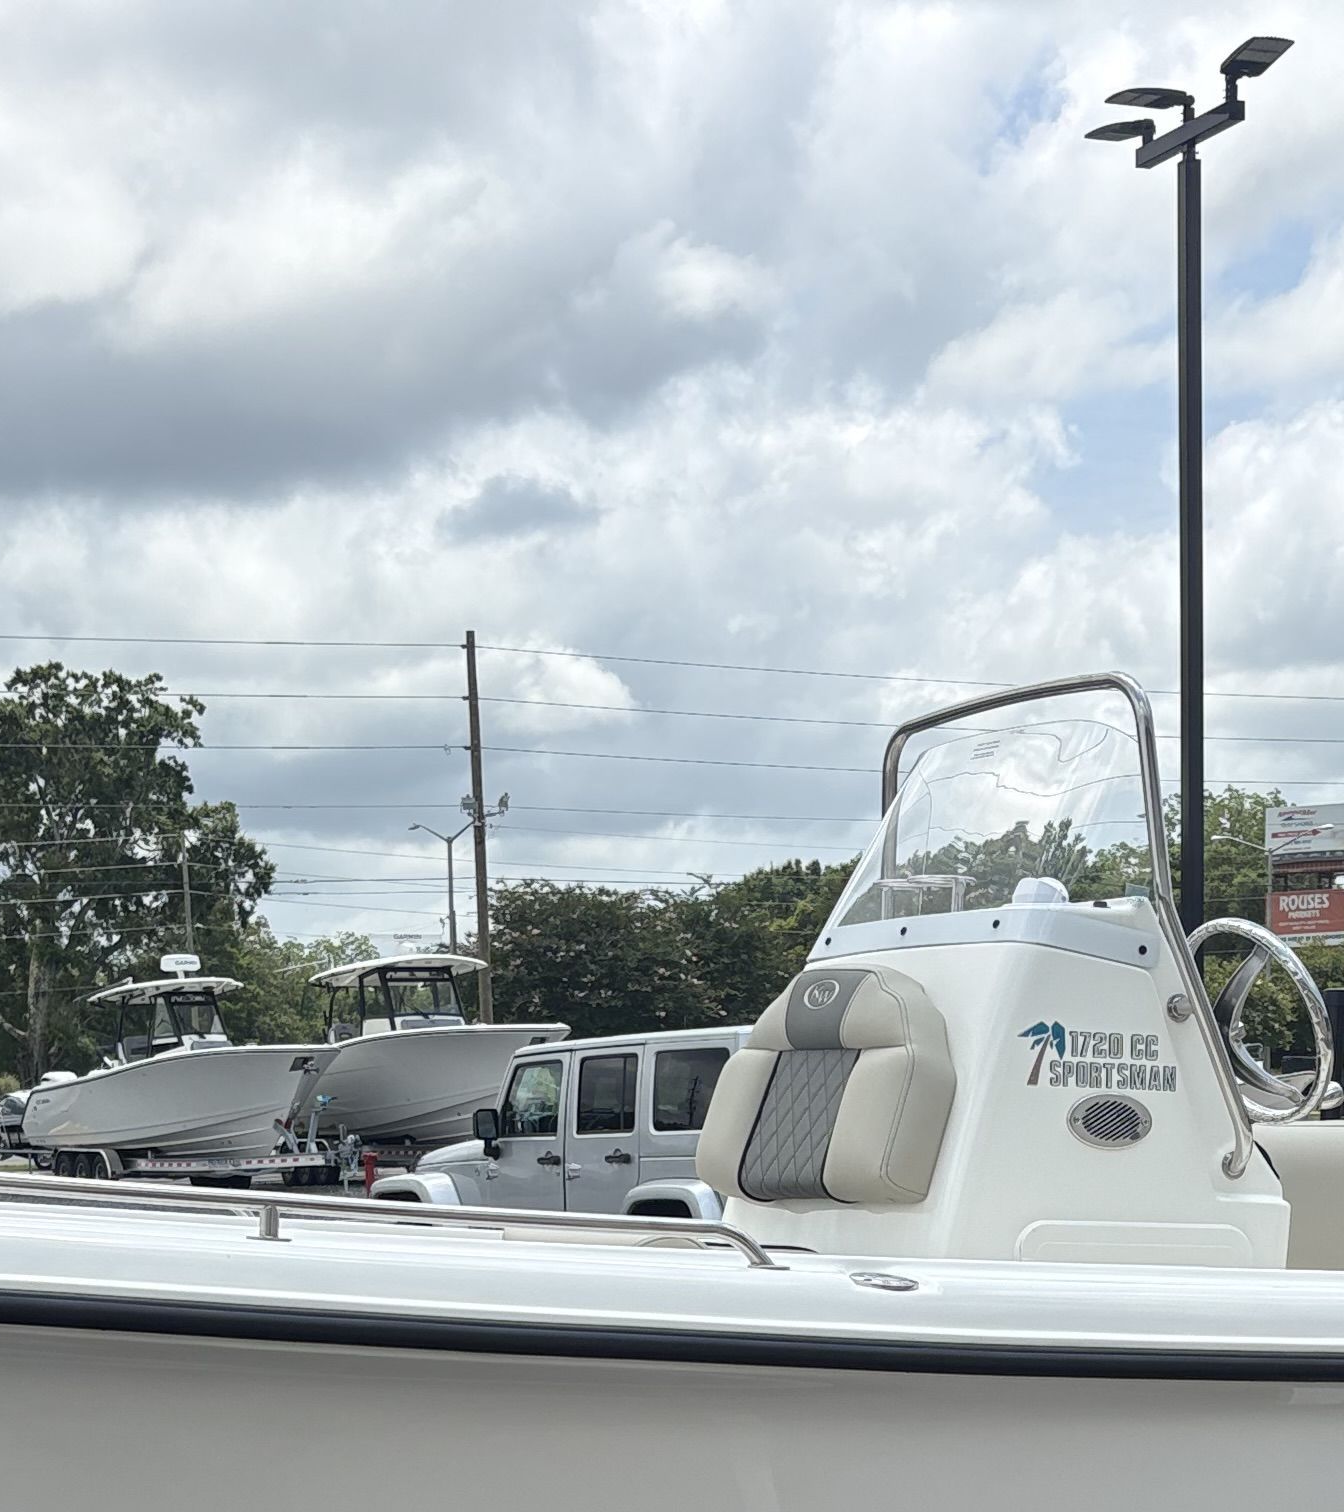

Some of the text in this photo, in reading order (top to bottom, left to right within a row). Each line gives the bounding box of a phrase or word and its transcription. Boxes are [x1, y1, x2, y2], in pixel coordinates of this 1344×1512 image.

[1279, 893, 1330, 912] ROUSES
[1069, 1030, 1159, 1061] 1720 CC
[1049, 1060, 1177, 1092] SPORTSMAN
